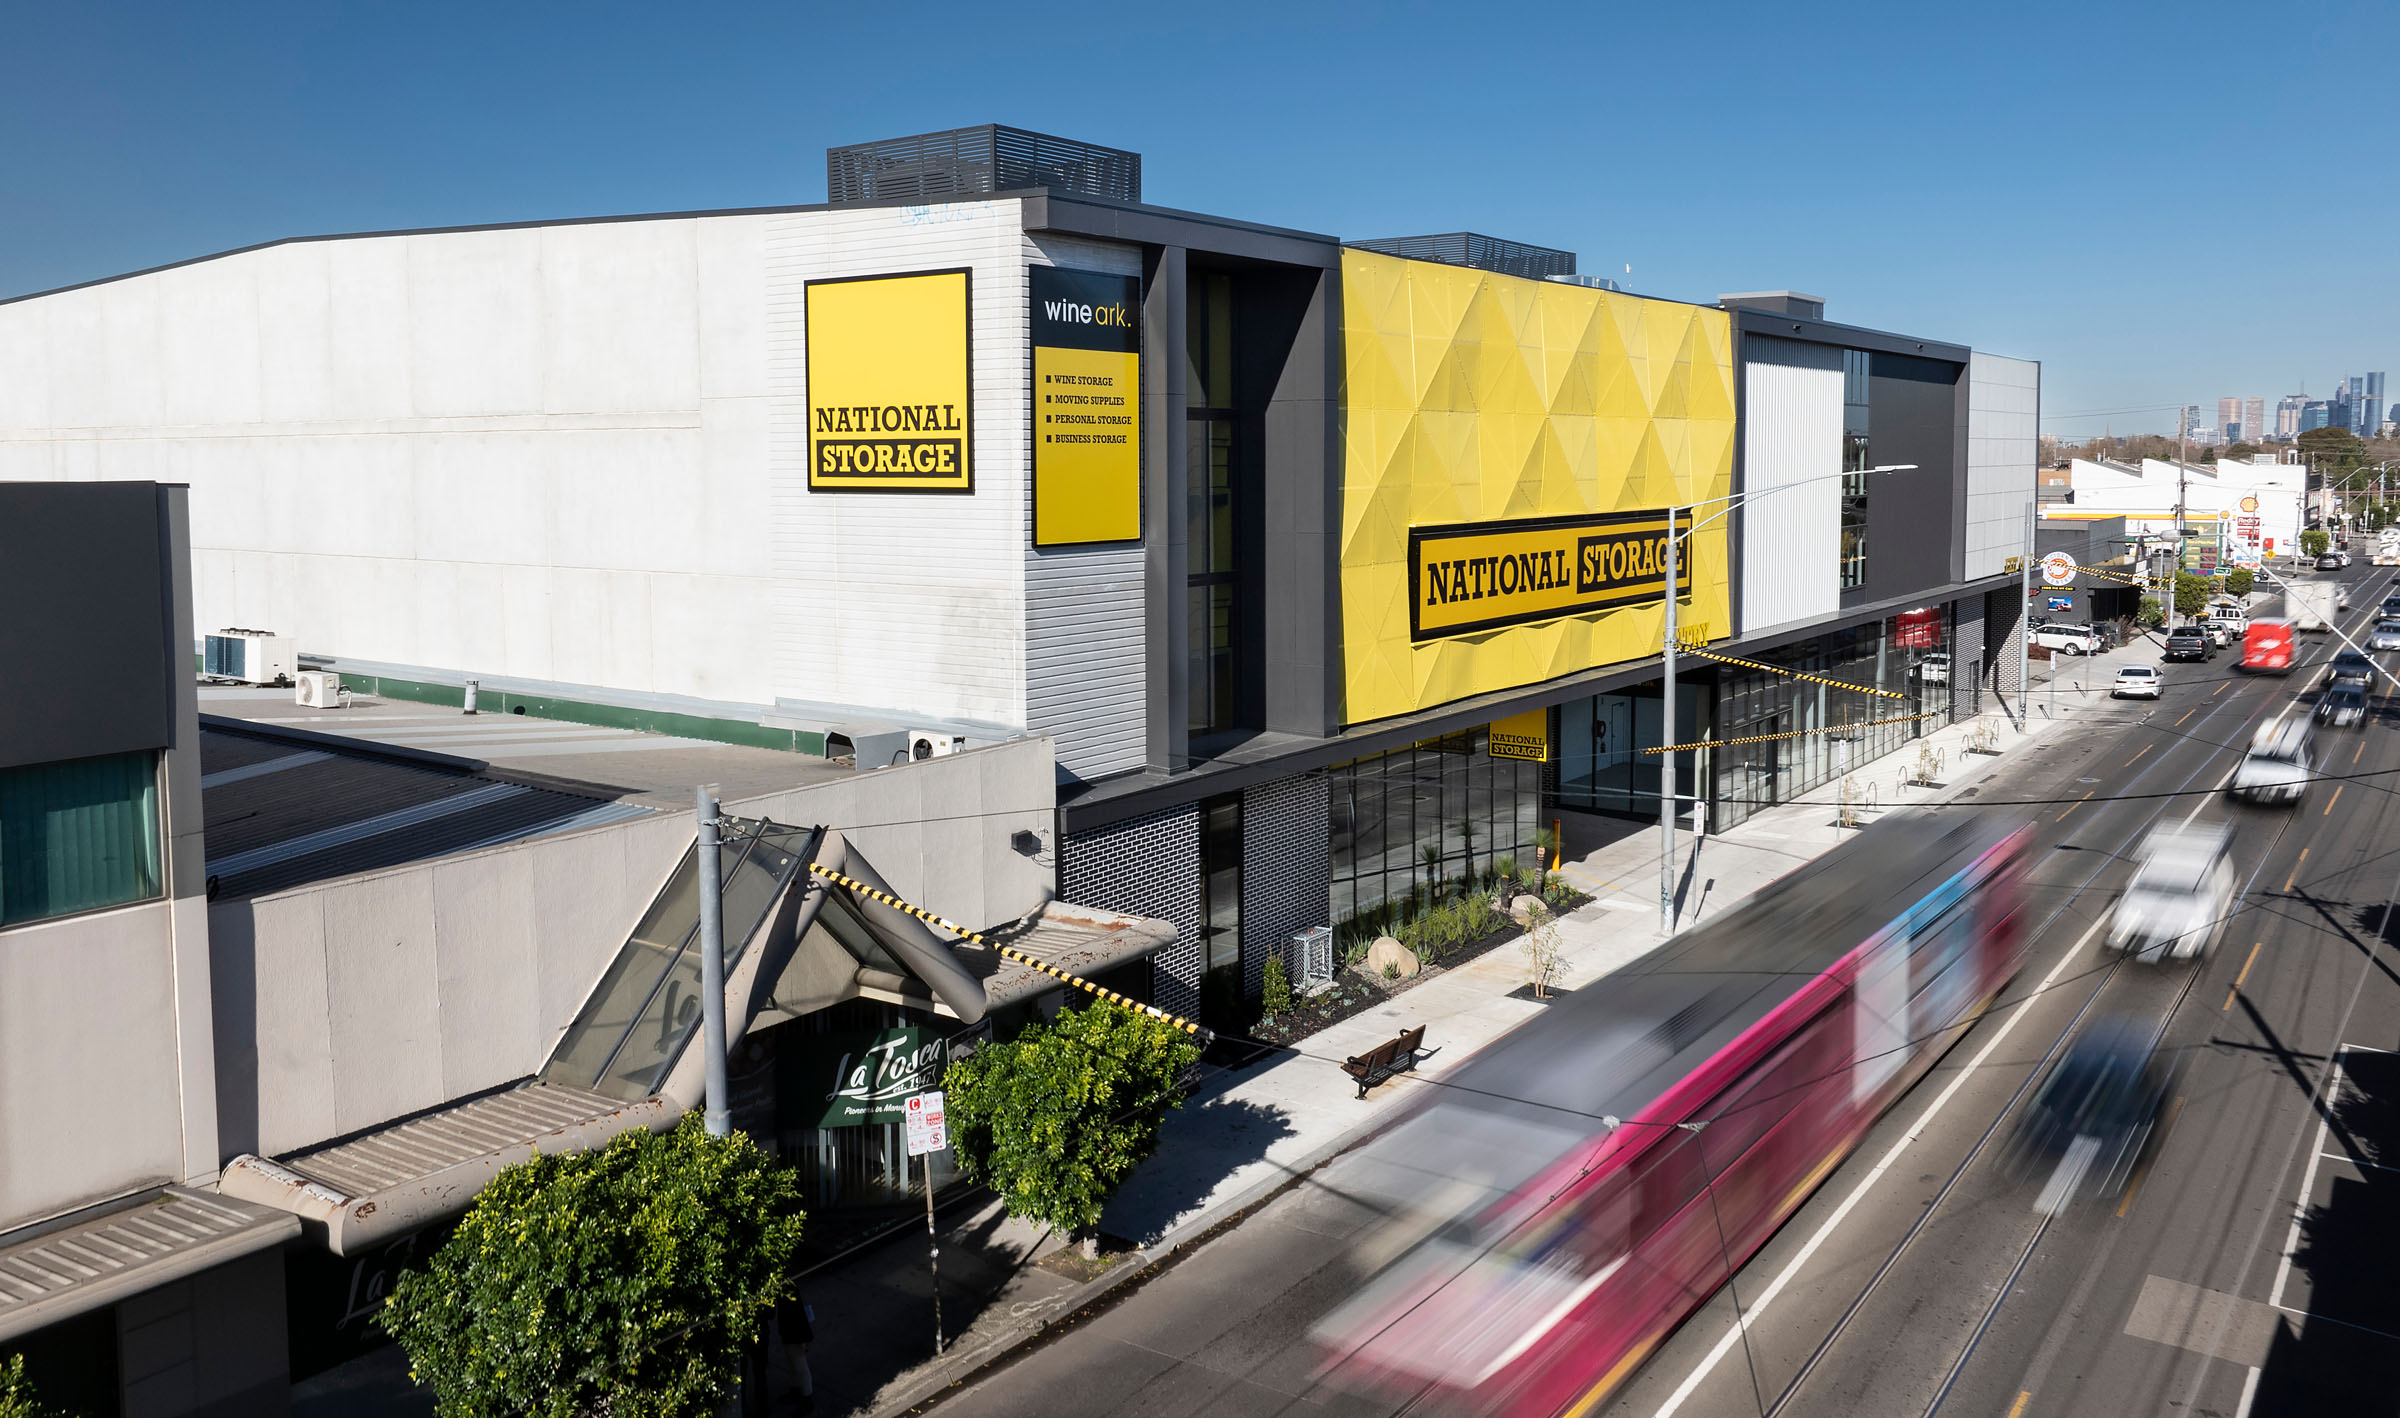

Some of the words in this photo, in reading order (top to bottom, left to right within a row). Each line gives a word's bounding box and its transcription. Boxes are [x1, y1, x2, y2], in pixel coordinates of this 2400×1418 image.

[1044, 298, 1093, 324] wine
[1095, 302, 1132, 328] ark.
[1054, 375, 1077, 385] WINE
[1077, 376, 1113, 386] STORAGE
[1055, 395, 1089, 405] MOVING
[1090, 396, 1125, 406] SUPPLIES
[816, 405, 961, 432] NATIONAL
[1055, 414, 1096, 424] PERSONAL
[1097, 415, 1132, 425] STORAGE
[1055, 434, 1091, 443] BUSINESS
[1092, 434, 1127, 444] STORAGE
[823, 444, 955, 473] STORAGE
[1427, 550, 1570, 606] NATIONAL
[1492, 733, 1545, 746] NATIONAL
[1493, 744, 1543, 757] STORAGE
[826, 1053, 869, 1101] La
[866, 1035, 943, 1089] Tosca
[844, 1106, 874, 1116] Pioneers
[875, 1105, 883, 1113] in
[911, 1099, 919, 1110] C
